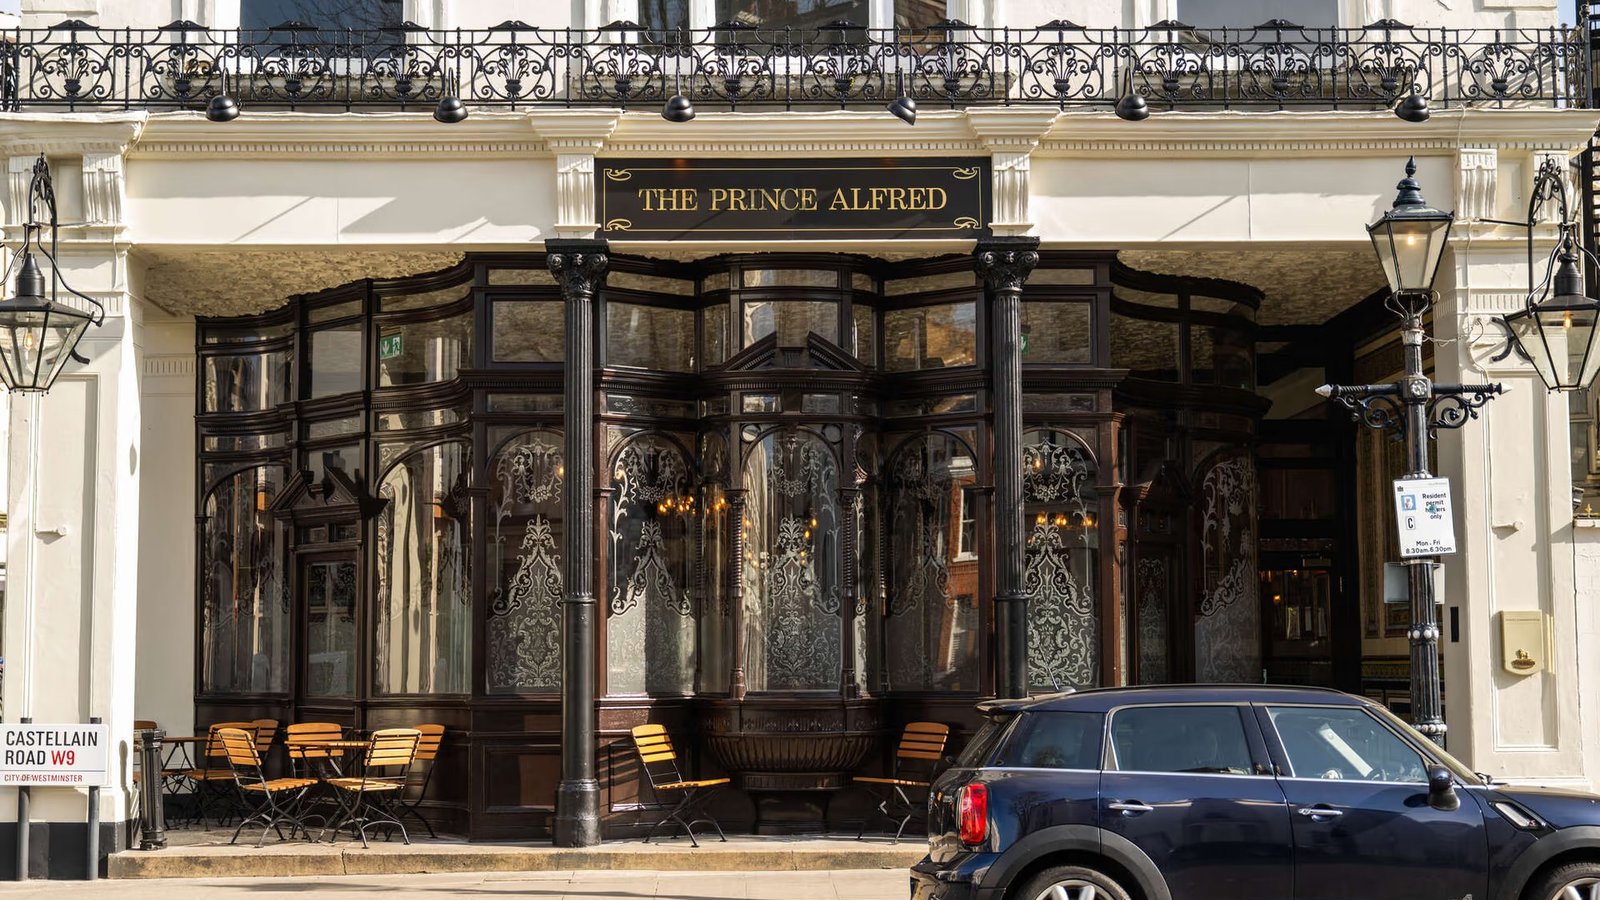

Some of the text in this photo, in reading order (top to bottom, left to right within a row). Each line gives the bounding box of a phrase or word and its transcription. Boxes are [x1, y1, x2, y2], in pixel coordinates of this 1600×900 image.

[638, 187, 948, 211] THE PRINCE ALFRED
[1407, 517, 1413, 528] C
[6, 731, 98, 747] CASTELLAIN
[5, 750, 75, 766] ROAD W9
[4, 774, 83, 782] CITY OF WESTMINSTER
